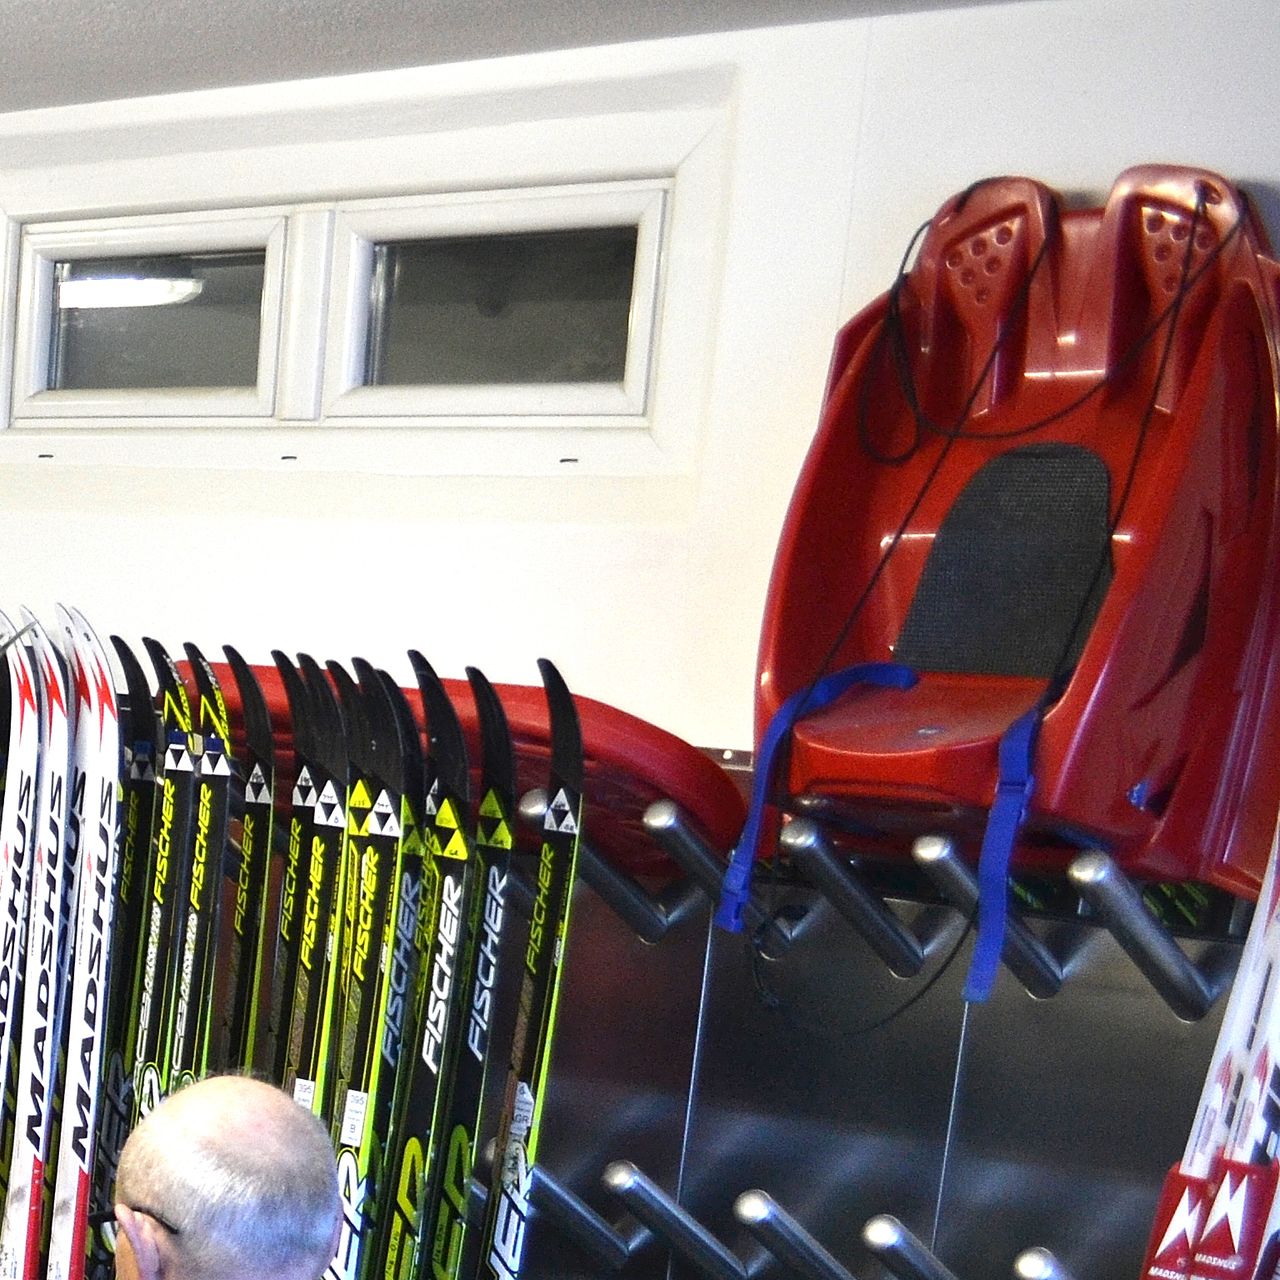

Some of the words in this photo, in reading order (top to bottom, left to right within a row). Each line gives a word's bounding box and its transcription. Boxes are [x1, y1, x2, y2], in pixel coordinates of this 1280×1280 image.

[153, 778, 176, 905] FISCHER
[190, 783, 212, 911] FISCHER
[233, 814, 255, 936] FISCHER
[280, 817, 302, 942] FISCHER
[300, 835, 326, 971] FISCHER
[526, 842, 555, 975] FISCHER
[25, 770, 63, 1156] MADSHUS
[70, 776, 115, 1172] MADSHUS
[352, 844, 379, 982] FISCHER
[382, 871, 421, 1068] FISCHER
[421, 874, 463, 1075] FISCHER
[467, 865, 509, 1063] FISCHER
